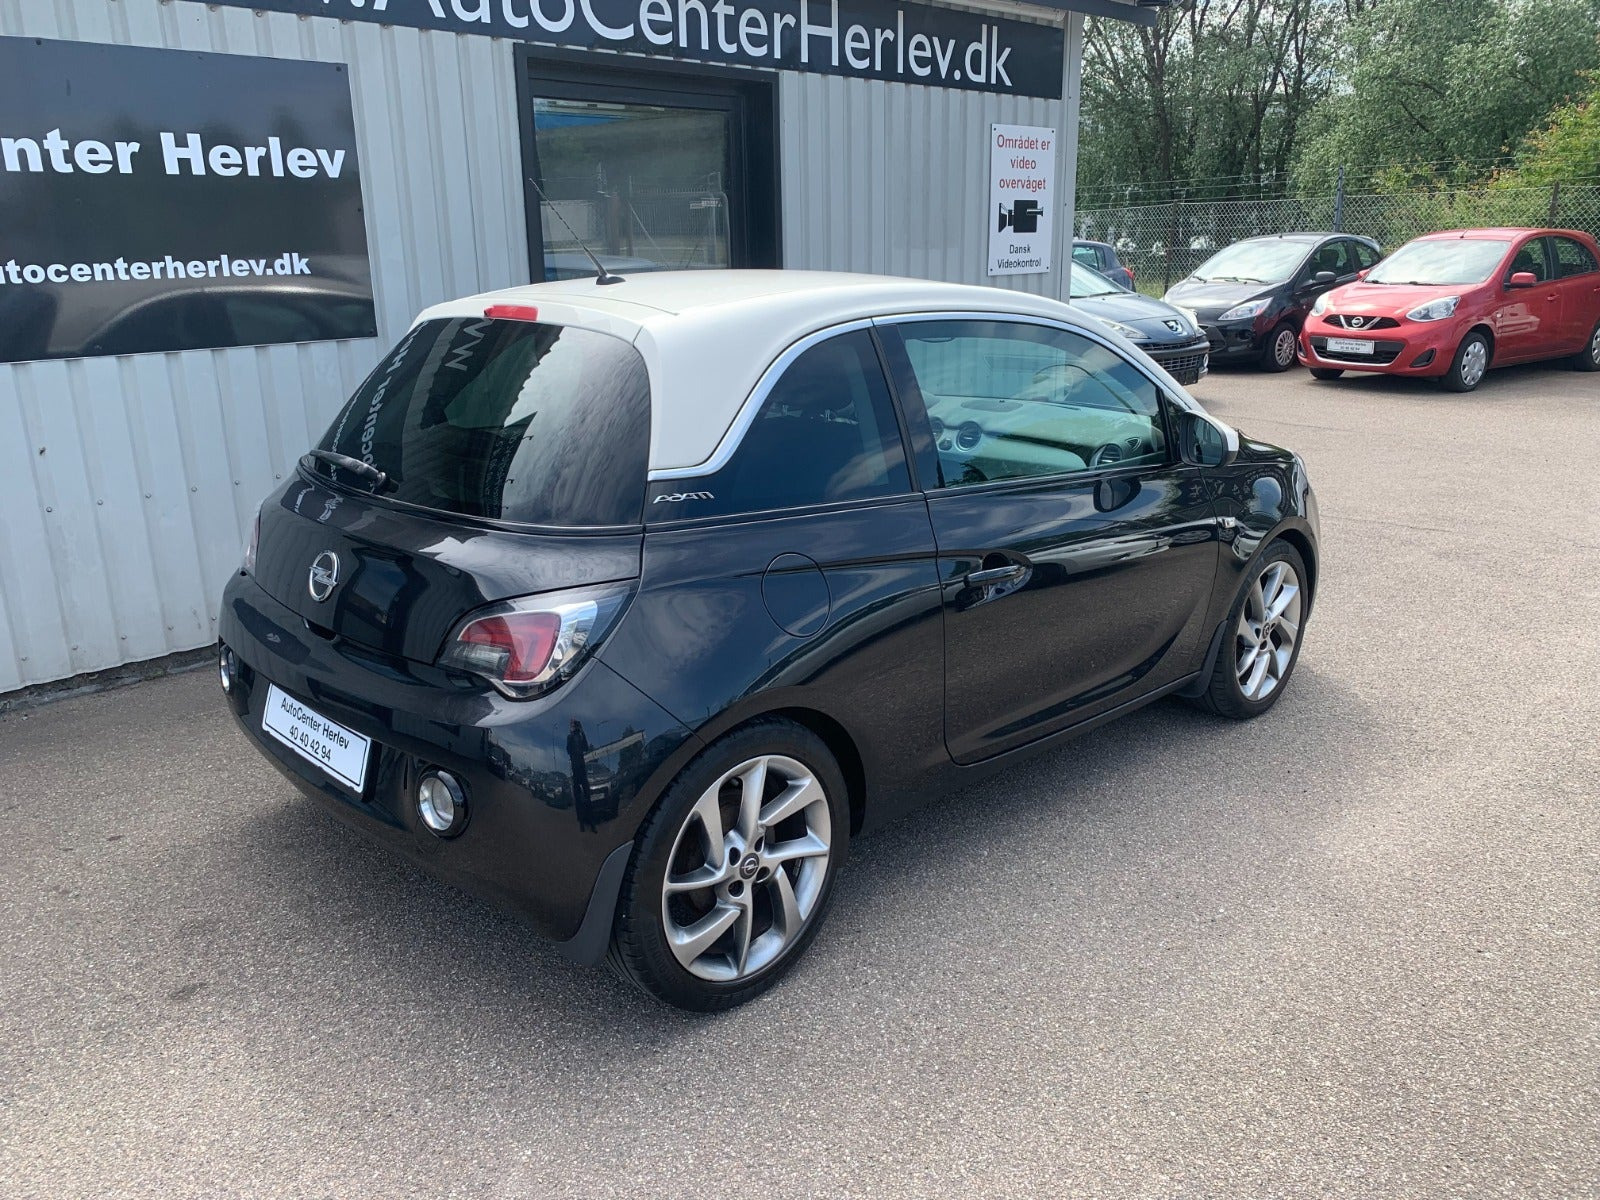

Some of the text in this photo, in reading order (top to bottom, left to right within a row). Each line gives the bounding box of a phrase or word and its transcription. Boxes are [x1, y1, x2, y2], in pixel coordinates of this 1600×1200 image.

[321, 0, 1013, 88] .utoCenterHerlev.dk
[160, 131, 347, 179] Herlev
[997, 134, 1051, 151] Området er
[1010, 155, 1037, 170] video
[999, 175, 1047, 193] overvåget
[1009, 244, 1031, 255] Dansk
[0, 252, 312, 285] tocenterherlev.dk
[997, 256, 1042, 270] Videokontrol
[280, 697, 350, 750] AutoCenter Herlev
[289, 724, 332, 763] 40 40 42 94
